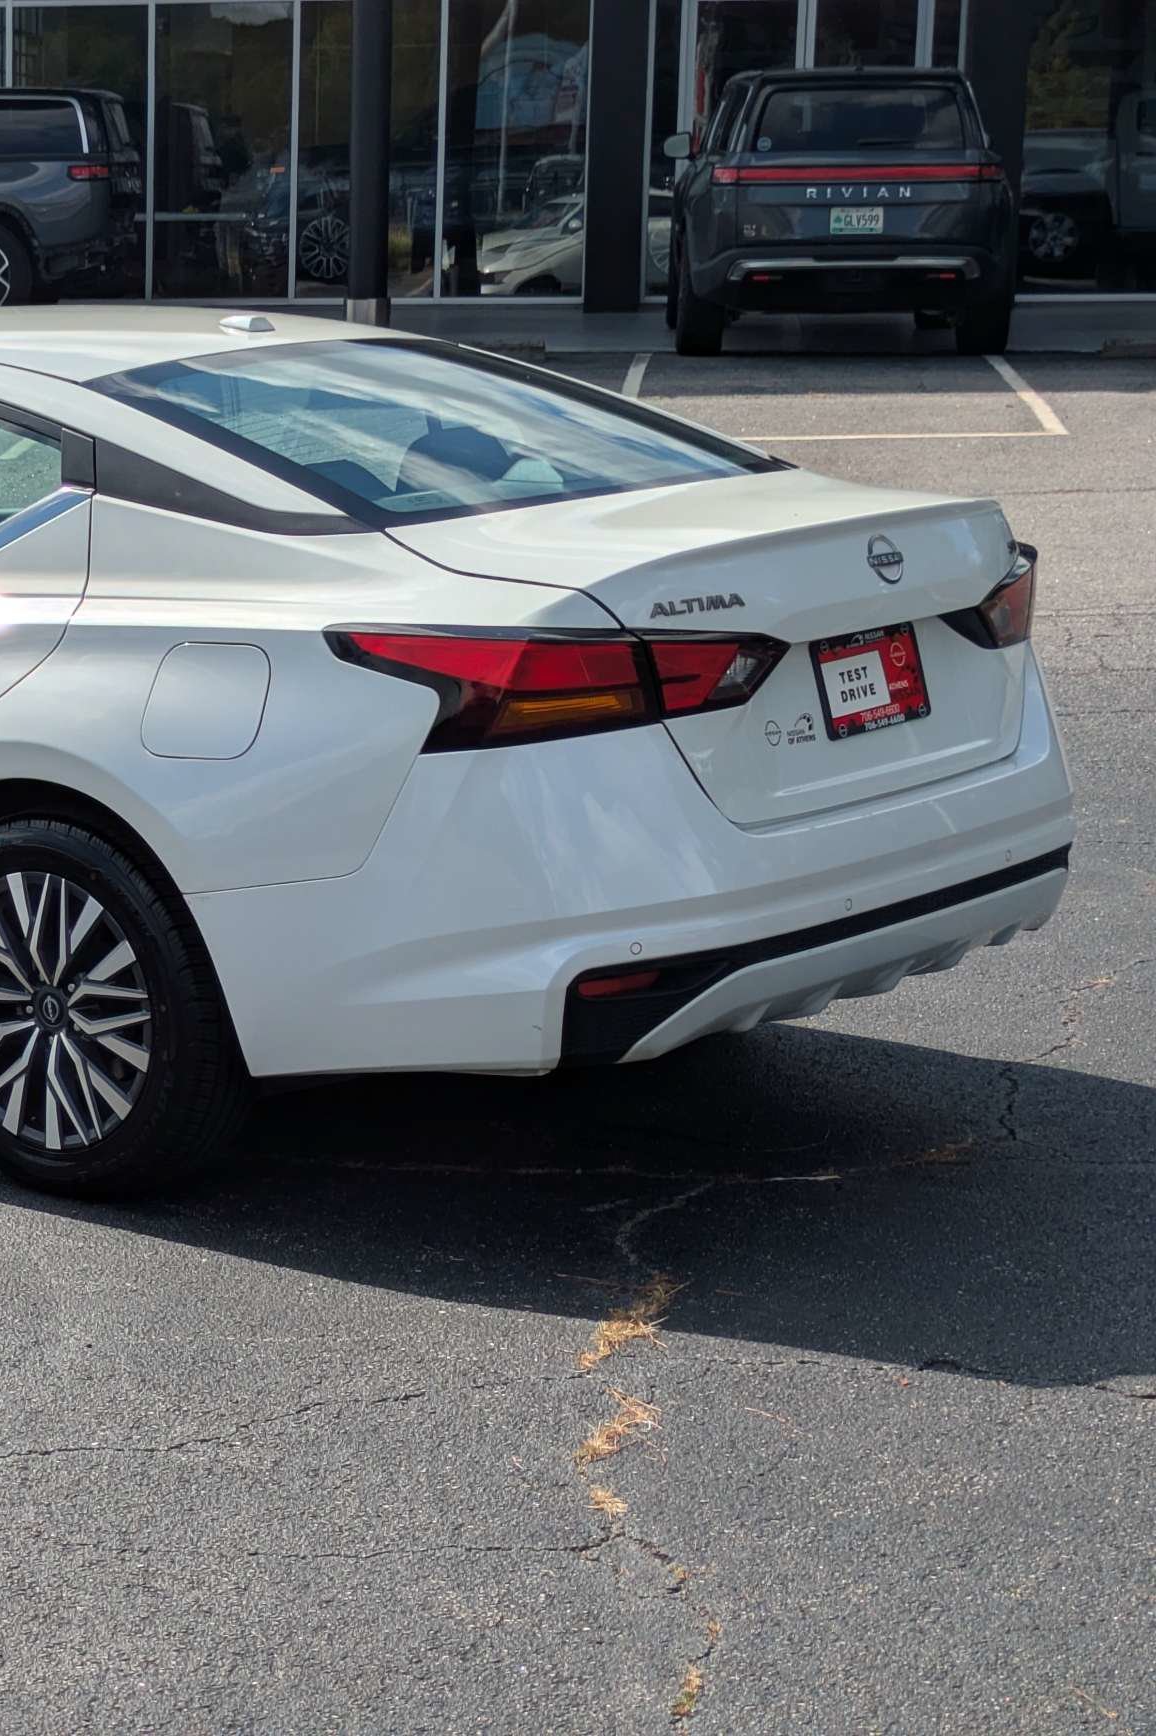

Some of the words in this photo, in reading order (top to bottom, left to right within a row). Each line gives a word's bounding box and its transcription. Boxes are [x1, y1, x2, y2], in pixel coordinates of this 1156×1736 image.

[806, 187, 911, 198] RIVIAN
[650, 593, 745, 618] ALTIMA
[838, 666, 868, 684] TEST
[840, 683, 877, 703] DRIVE
